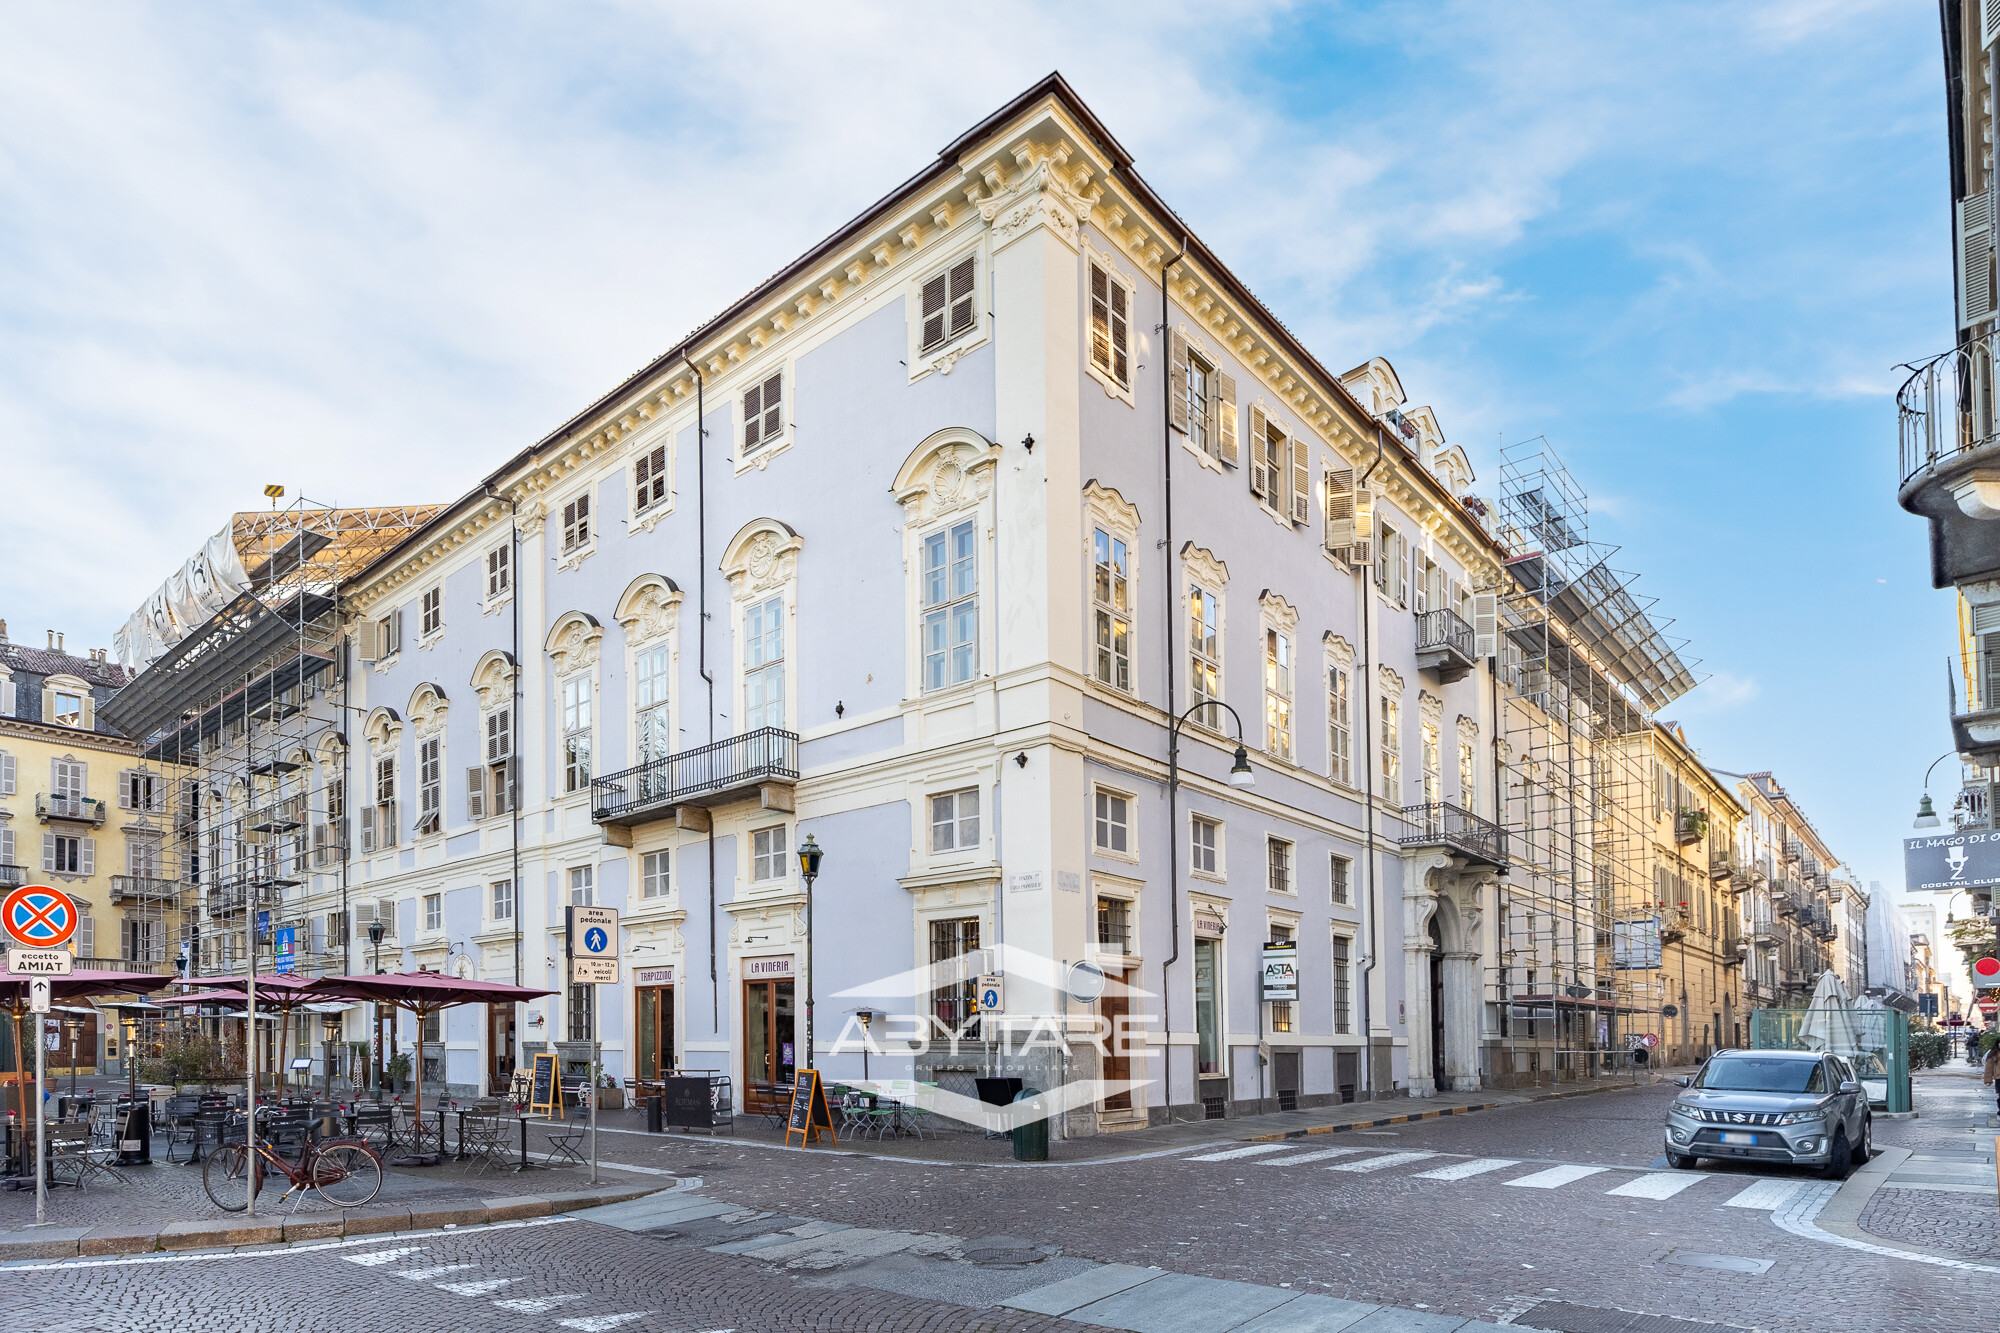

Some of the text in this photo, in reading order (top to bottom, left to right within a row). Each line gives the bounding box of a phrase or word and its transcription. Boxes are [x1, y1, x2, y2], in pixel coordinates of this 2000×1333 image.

[1909, 841, 1923, 849] IL
[1926, 836, 1965, 848] MAGO
[1968, 834, 1986, 844] DI
[1921, 880, 1970, 889] COCKTAIL
[18, 961, 63, 971] AMIAT
[751, 960, 789, 973] LA VINERIA
[1265, 963, 1294, 975] ASTA
[640, 970, 672, 982] TRAPIZZINO
